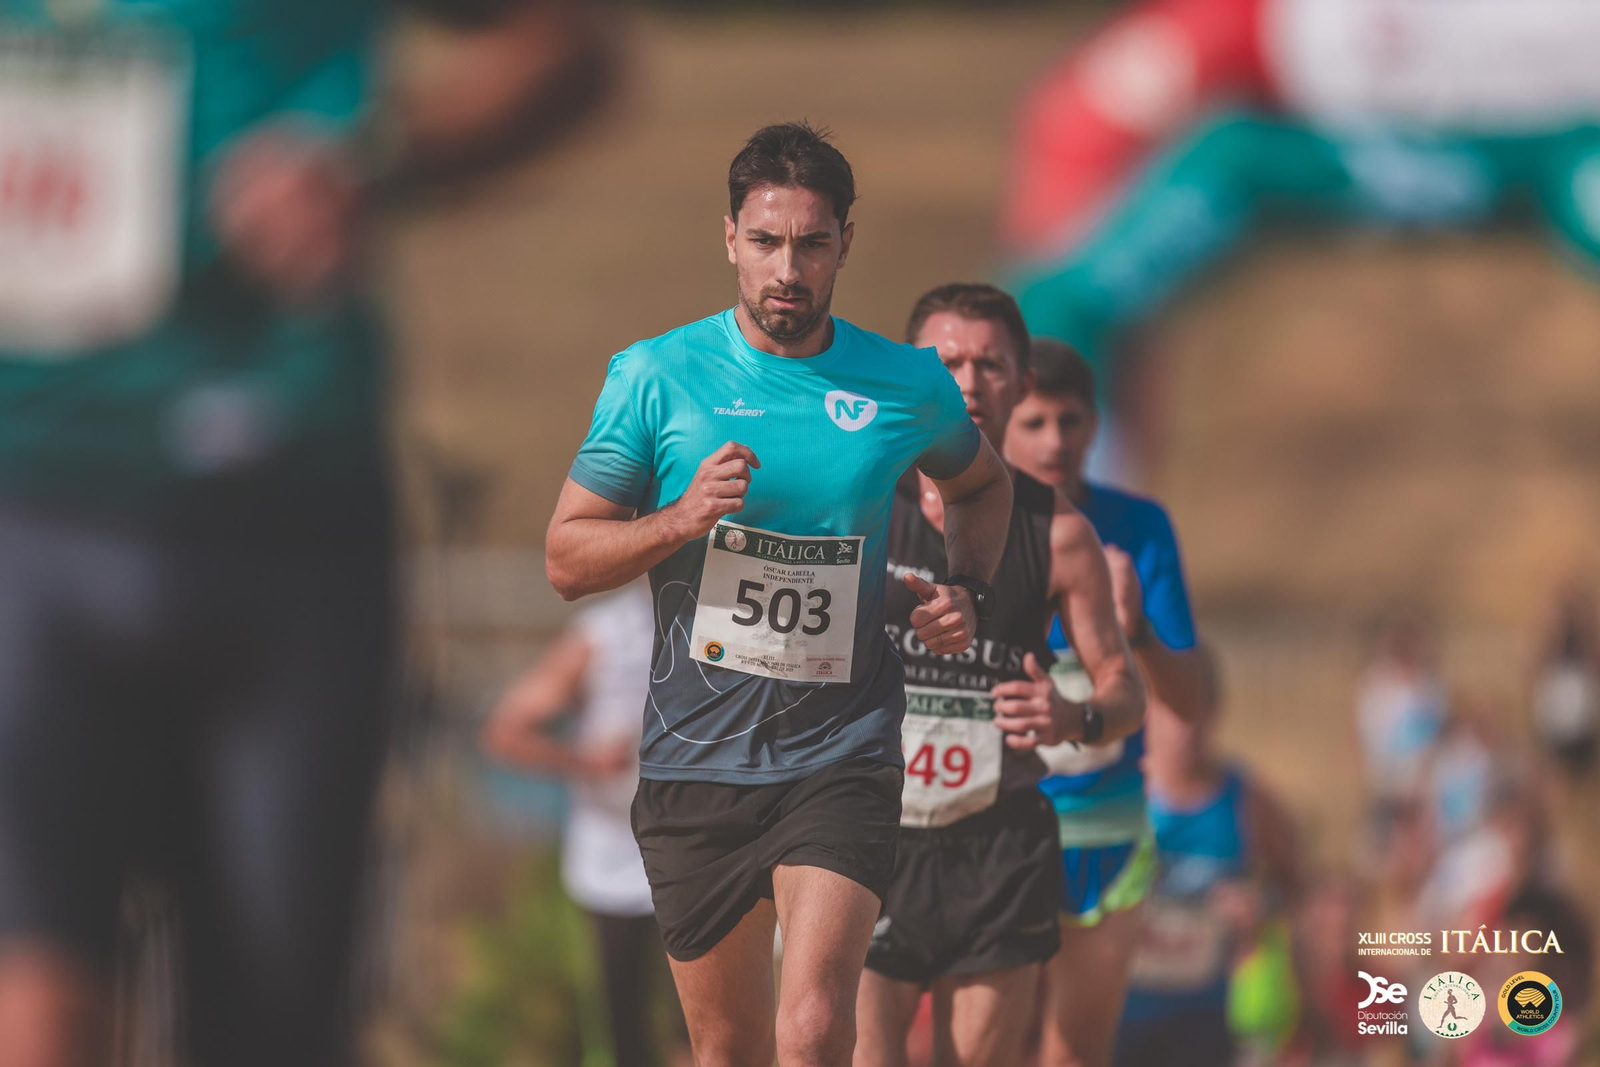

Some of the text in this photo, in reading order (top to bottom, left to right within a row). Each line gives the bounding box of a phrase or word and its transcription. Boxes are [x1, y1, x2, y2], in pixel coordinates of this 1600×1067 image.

[713, 407, 766, 417] TEAMERGY
[834, 398, 870, 421] NF
[757, 538, 826, 561] ITÁLICA
[763, 572, 815, 585] INDEPENDIENTE
[731, 578, 832, 636] 503
[901, 741, 972, 788] 49
